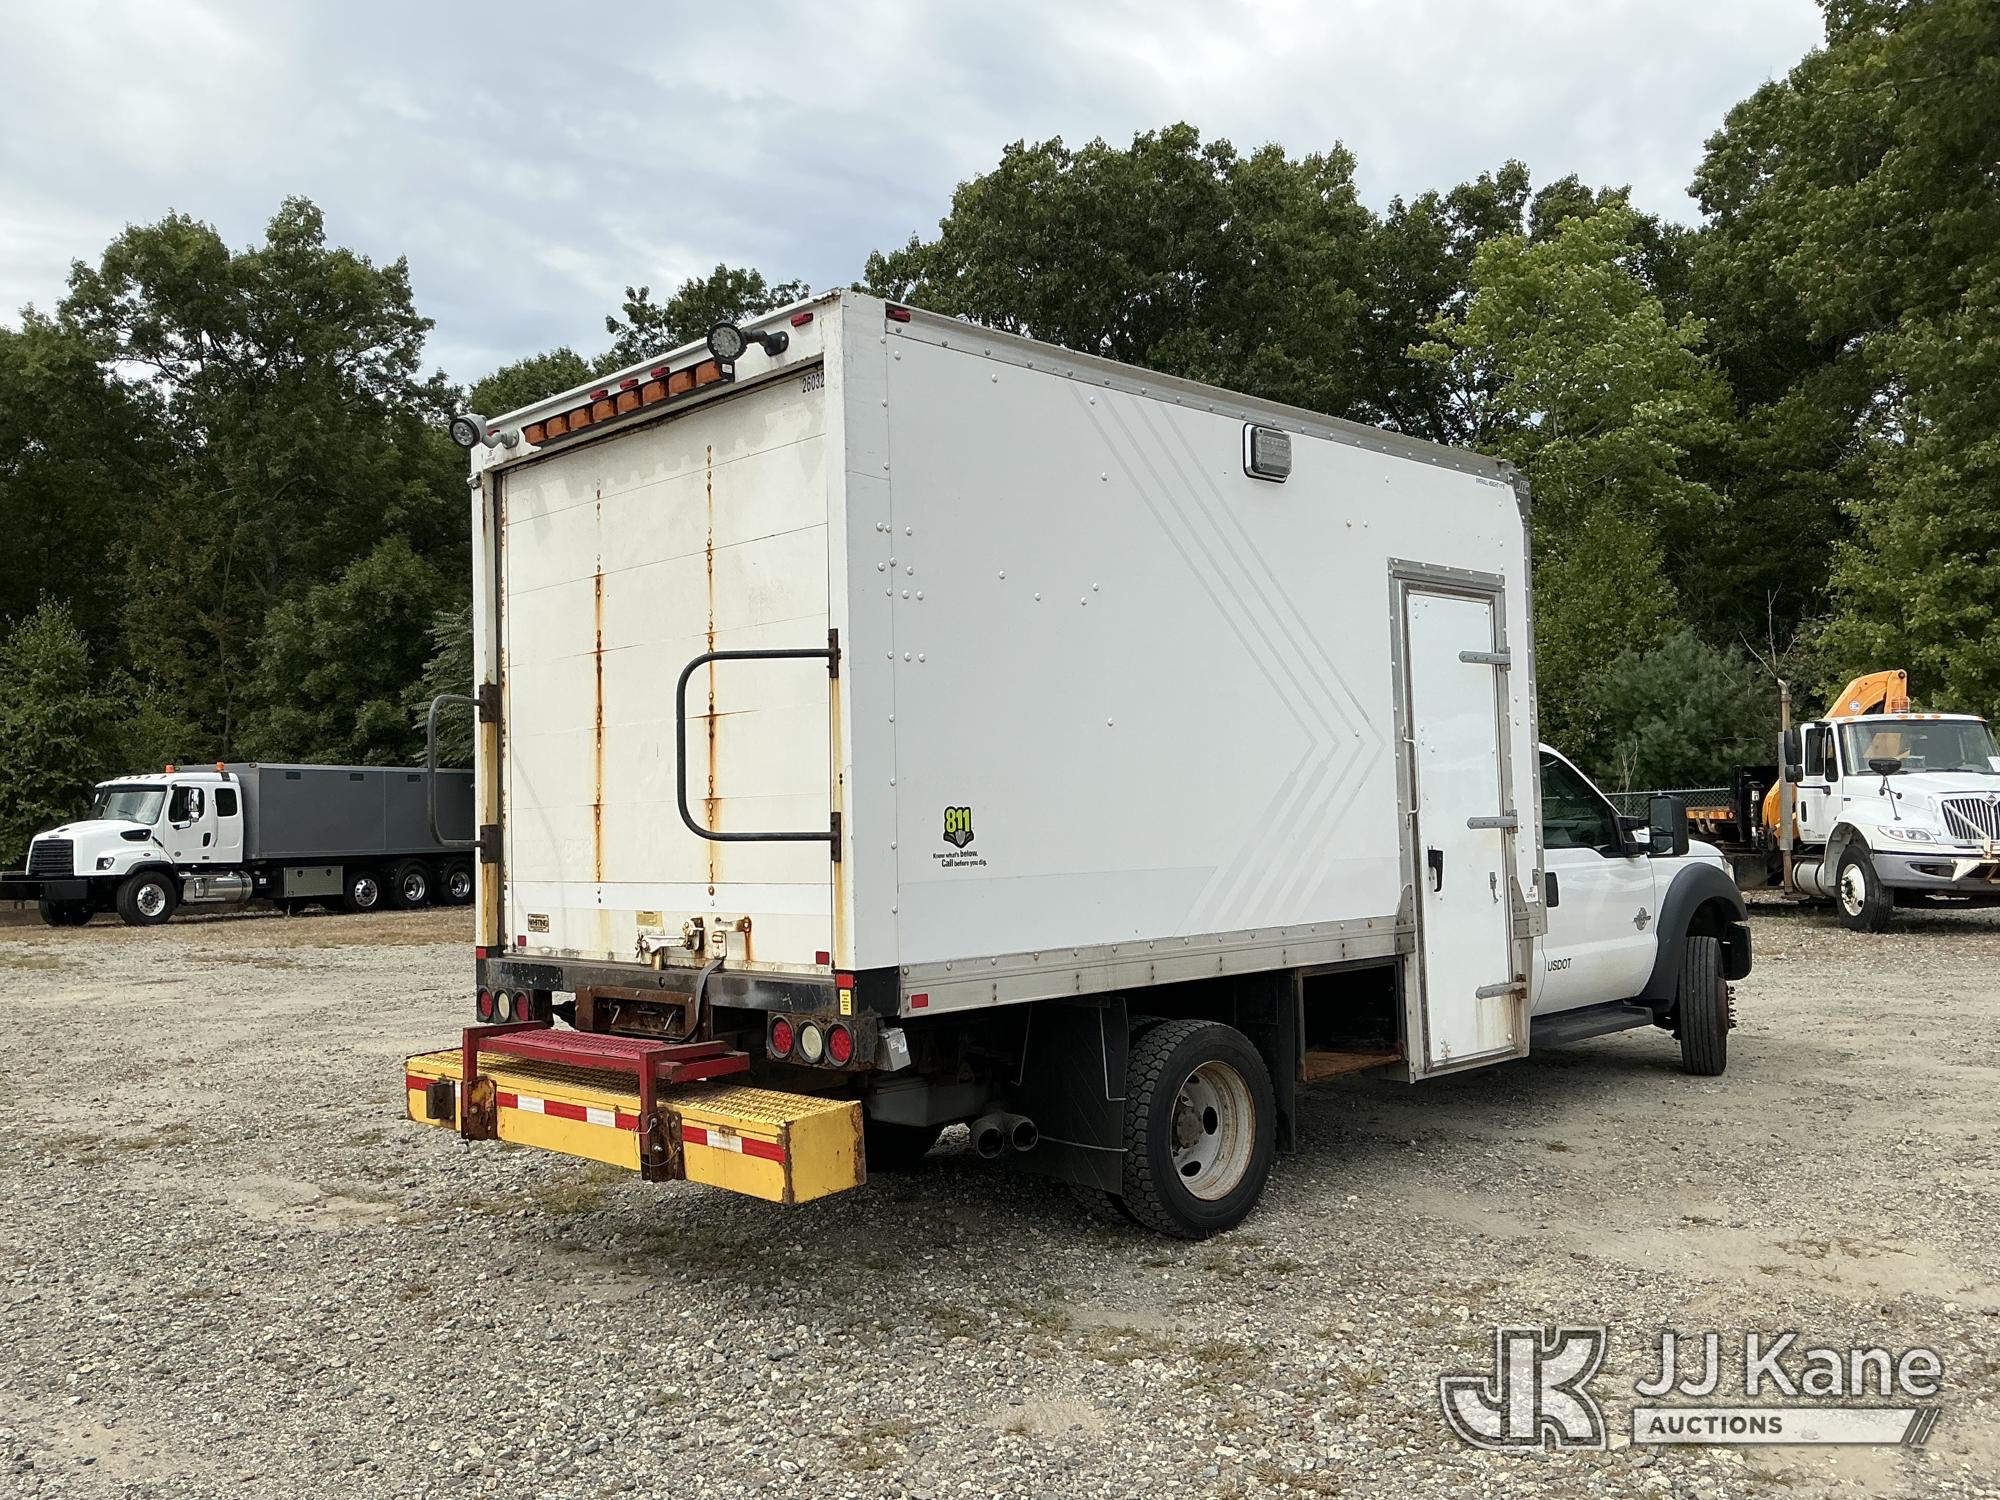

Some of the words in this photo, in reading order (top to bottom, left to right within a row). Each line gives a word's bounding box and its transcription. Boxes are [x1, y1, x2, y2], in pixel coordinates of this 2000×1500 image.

[945, 807, 971, 833] 811
[941, 859, 954, 867] Call
[1547, 957, 1572, 972] USDOT
